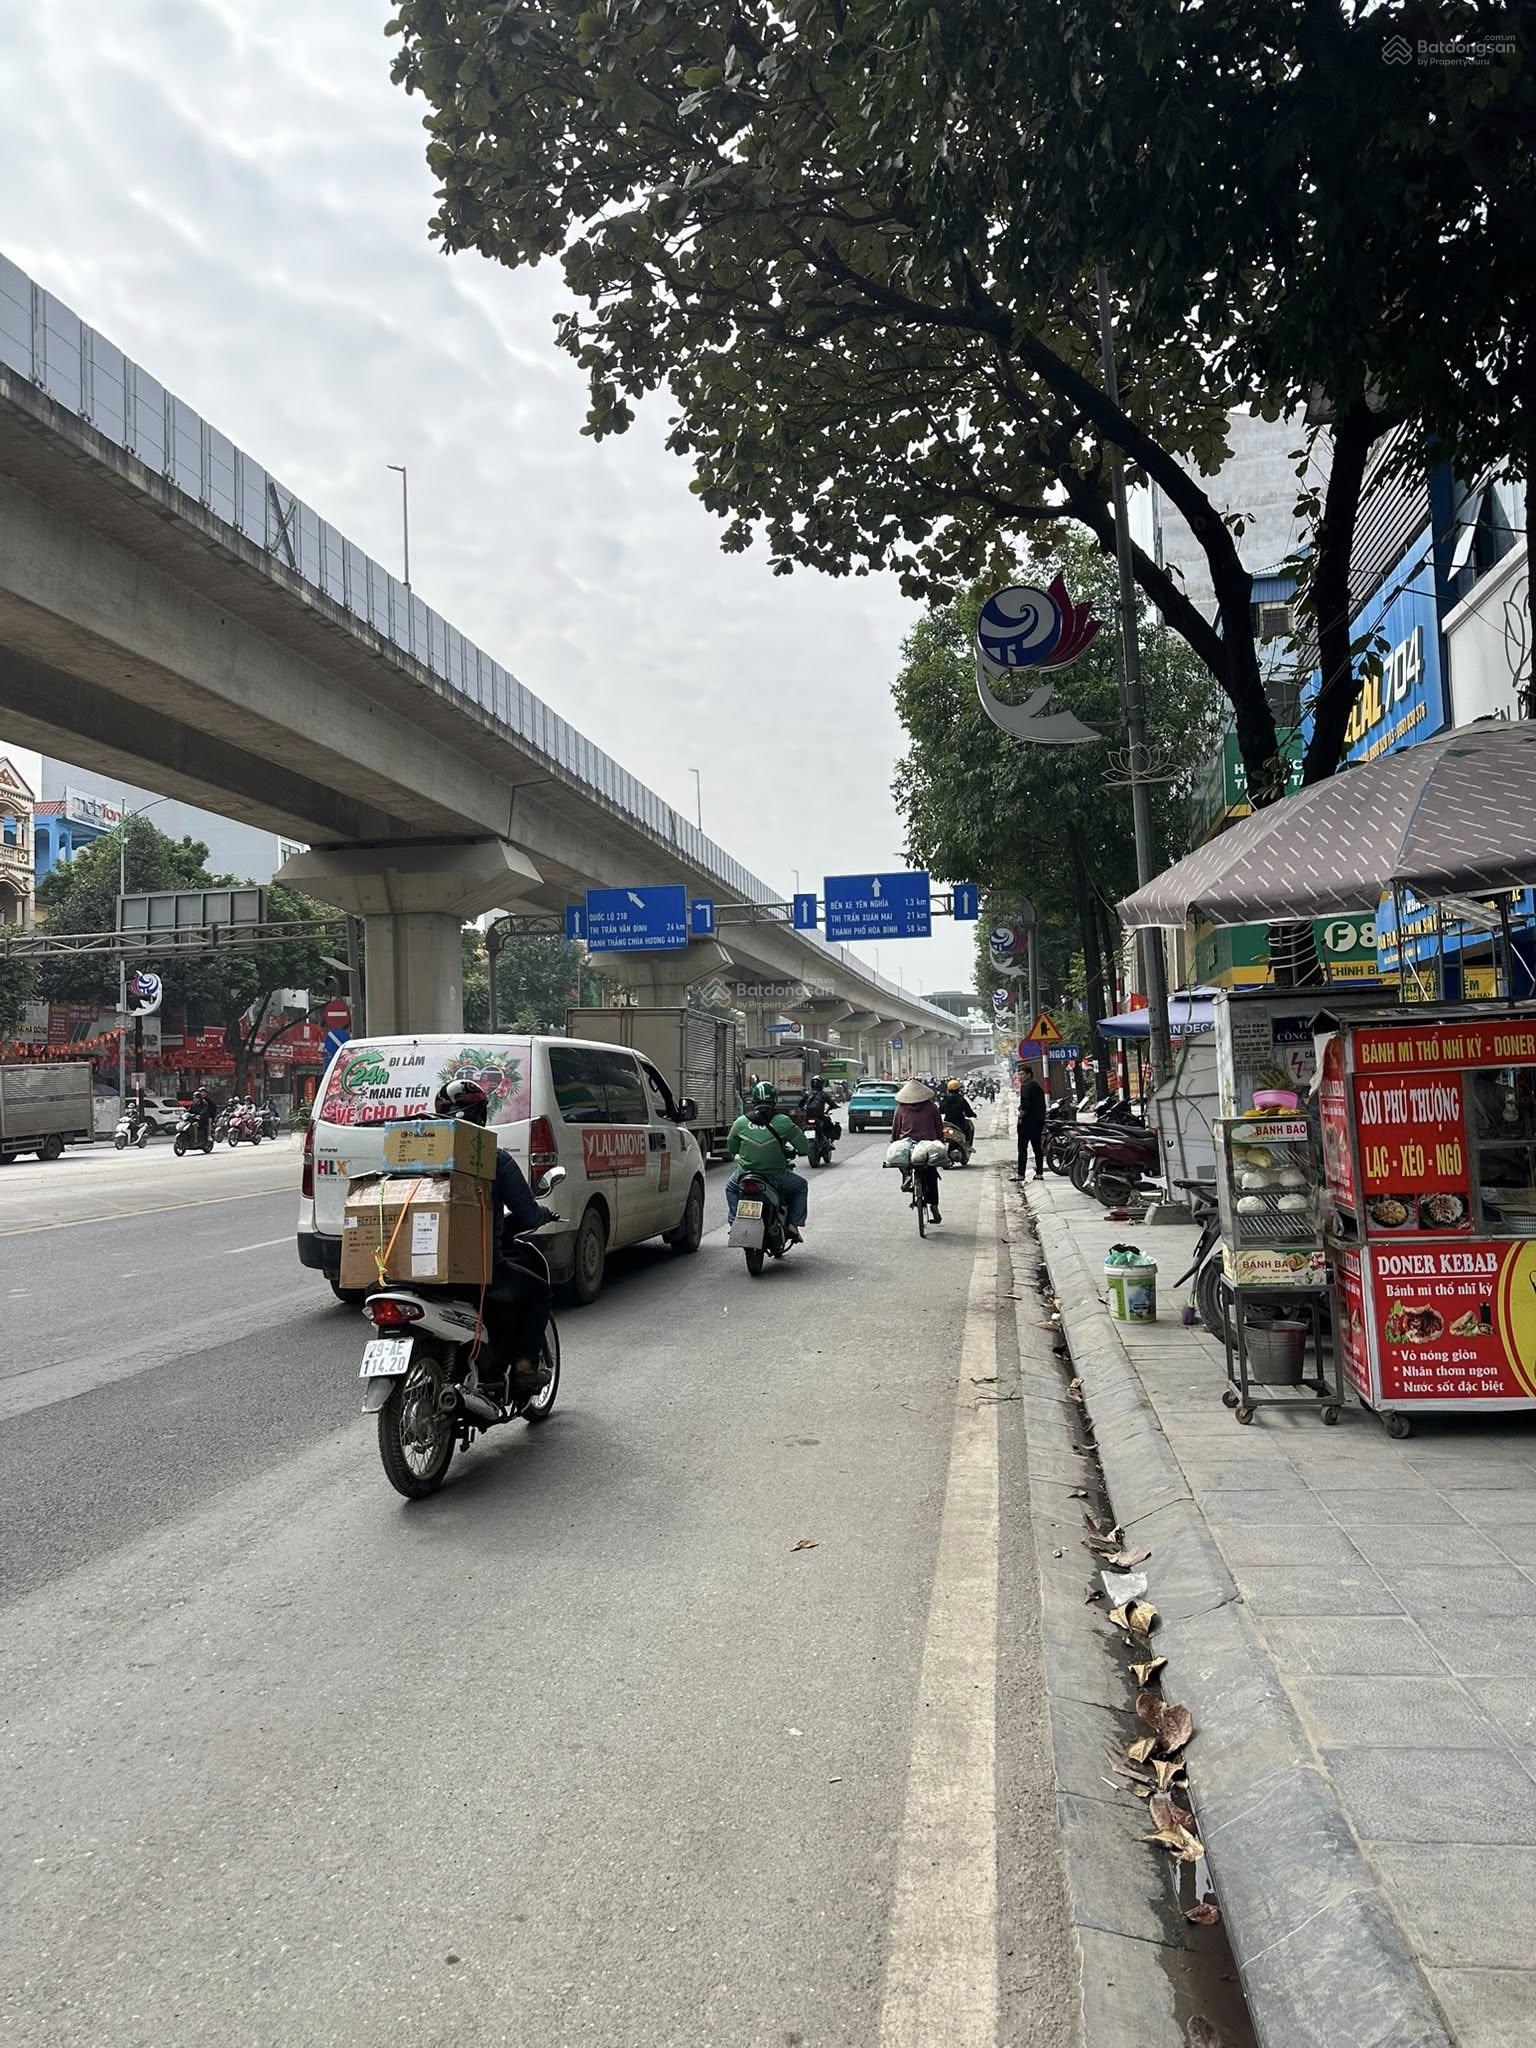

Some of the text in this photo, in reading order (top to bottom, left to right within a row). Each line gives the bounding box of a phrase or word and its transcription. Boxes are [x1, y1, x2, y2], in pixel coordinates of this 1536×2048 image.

[916, 898, 927, 906] km
[916, 911, 927, 919] km
[917, 924, 928, 932] km
[1362, 1039, 1395, 1063] BÁNH
[1398, 1037, 1414, 1062] MÌ
[1416, 1032, 1439, 1061] THỔ
[1443, 1035, 1464, 1059] NHĨ
[1494, 1034, 1536, 1057] DONER
[369, 1087, 402, 1100] MANG
[1360, 1080, 1383, 1125] XÔI
[1383, 1080, 1408, 1124] PHÚ
[595, 1133, 645, 1157] LALAMOVE
[1365, 1145, 1389, 1184] LẠC
[1400, 1138, 1425, 1176] XÉO
[1435, 1136, 1462, 1176] NGÔ
[1377, 1254, 1436, 1275] DONER
[1440, 1252, 1498, 1273] KEBAB
[1386, 1283, 1414, 1296] Bánh
[1435, 1281, 1455, 1295] thổ
[1458, 1282, 1476, 1295] nhĩ
[1403, 1366, 1433, 1377] Nhân
[1469, 1368, 1498, 1377] ngon
[1404, 1381, 1433, 1392] Nước
